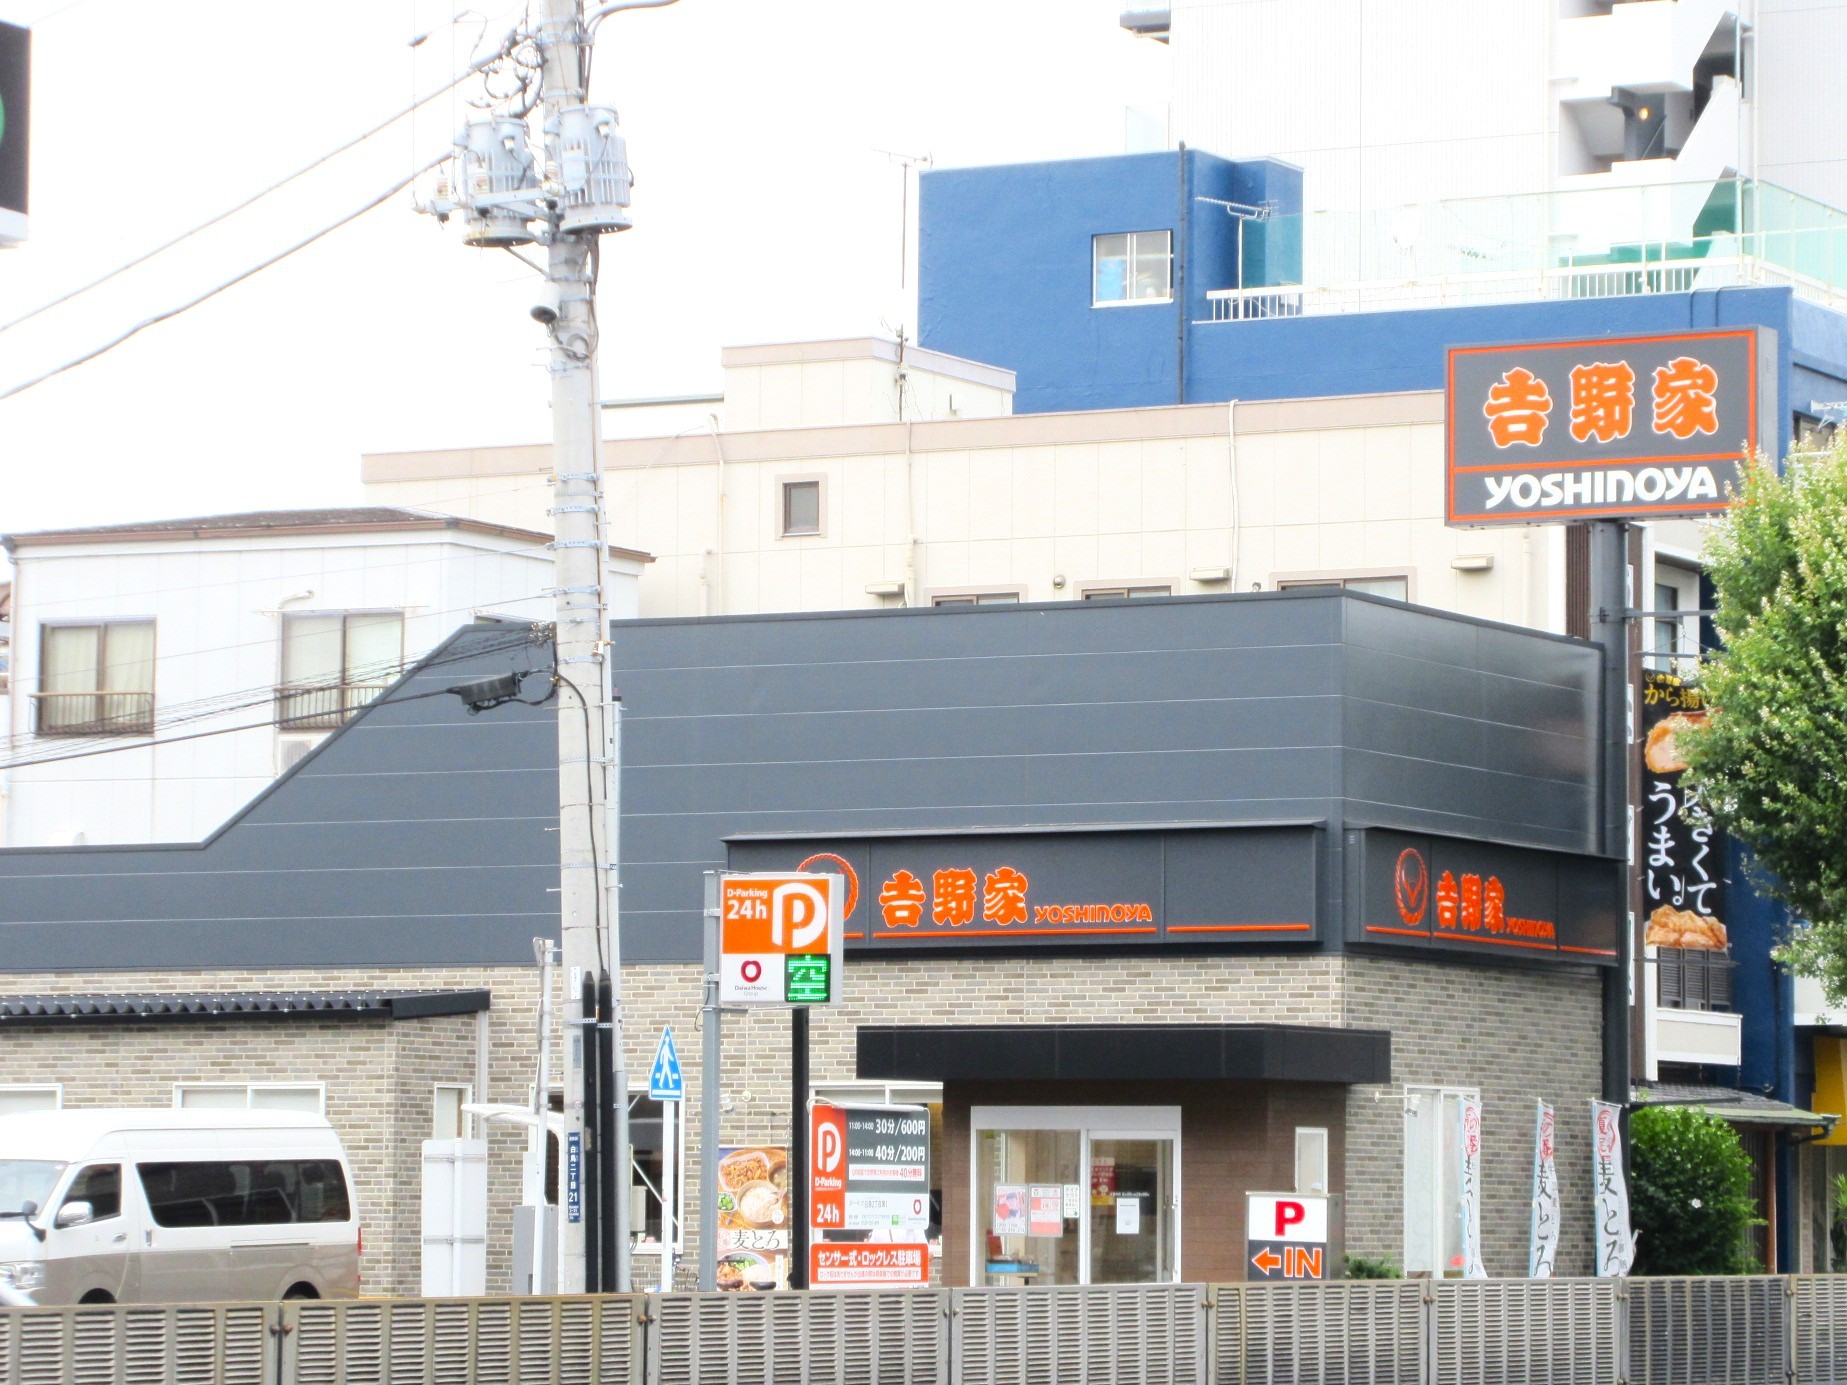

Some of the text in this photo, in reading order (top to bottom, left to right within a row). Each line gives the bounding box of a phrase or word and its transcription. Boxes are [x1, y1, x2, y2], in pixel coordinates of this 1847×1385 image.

[1483, 356, 1719, 448] 吉野家
[1485, 466, 1718, 509] YOSHINOYA
[1644, 684, 1708, 709] から揚
[726, 888, 769, 899] D-Parking
[878, 866, 1153, 928] 吉野家 YOSHINOYA
[1435, 869, 1555, 940] 吉野家 YOSHINOYA
[726, 899, 767, 919] 24h
[788, 954, 827, 1001] 空
[568, 1192, 578, 1203] 21
[816, 1203, 840, 1224] 24h
[1275, 1200, 1306, 1237] P
[731, 1228, 780, 1250] 麦とろ
[818, 1250, 921, 1266] センサー式・ロックレス駐車場
[1284, 1246, 1323, 1279] IN
